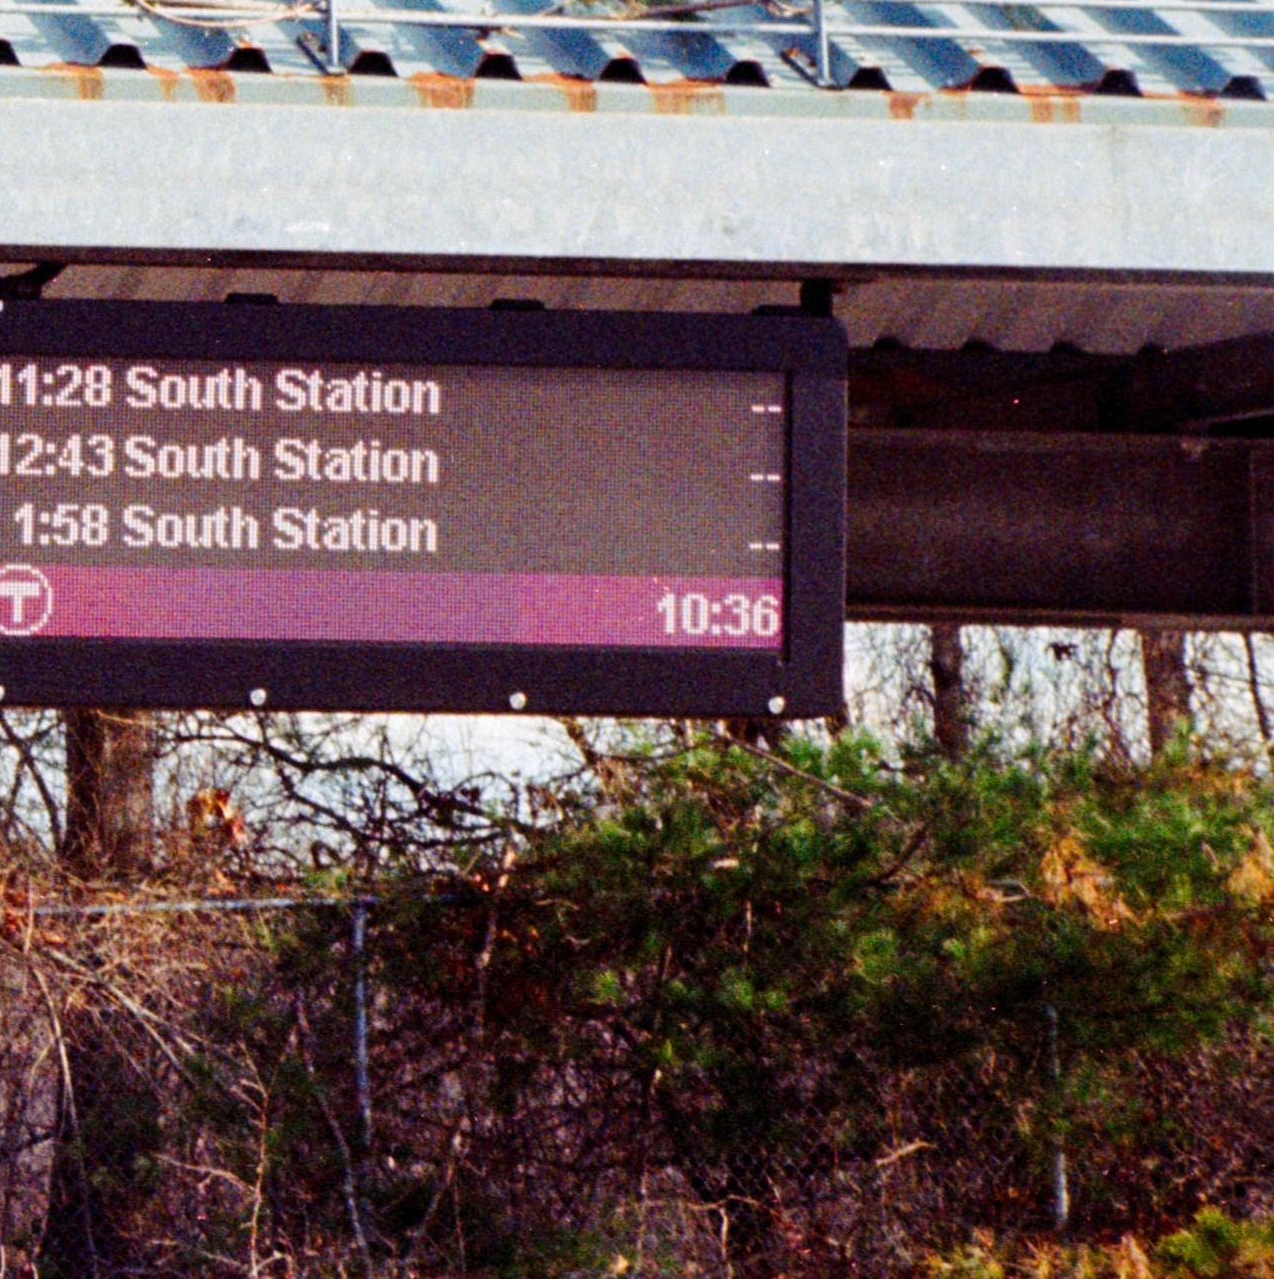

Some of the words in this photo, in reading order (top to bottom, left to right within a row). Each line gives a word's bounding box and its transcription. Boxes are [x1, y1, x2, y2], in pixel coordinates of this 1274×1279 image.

[126, 366, 263, 411] South
[276, 369, 441, 414] Station
[124, 436, 260, 480] South
[274, 438, 439, 483] Station
[14, 502, 109, 545] 1:58
[122, 505, 259, 550] South
[273, 508, 438, 553] Station
[657, 592, 780, 636] 10:36
